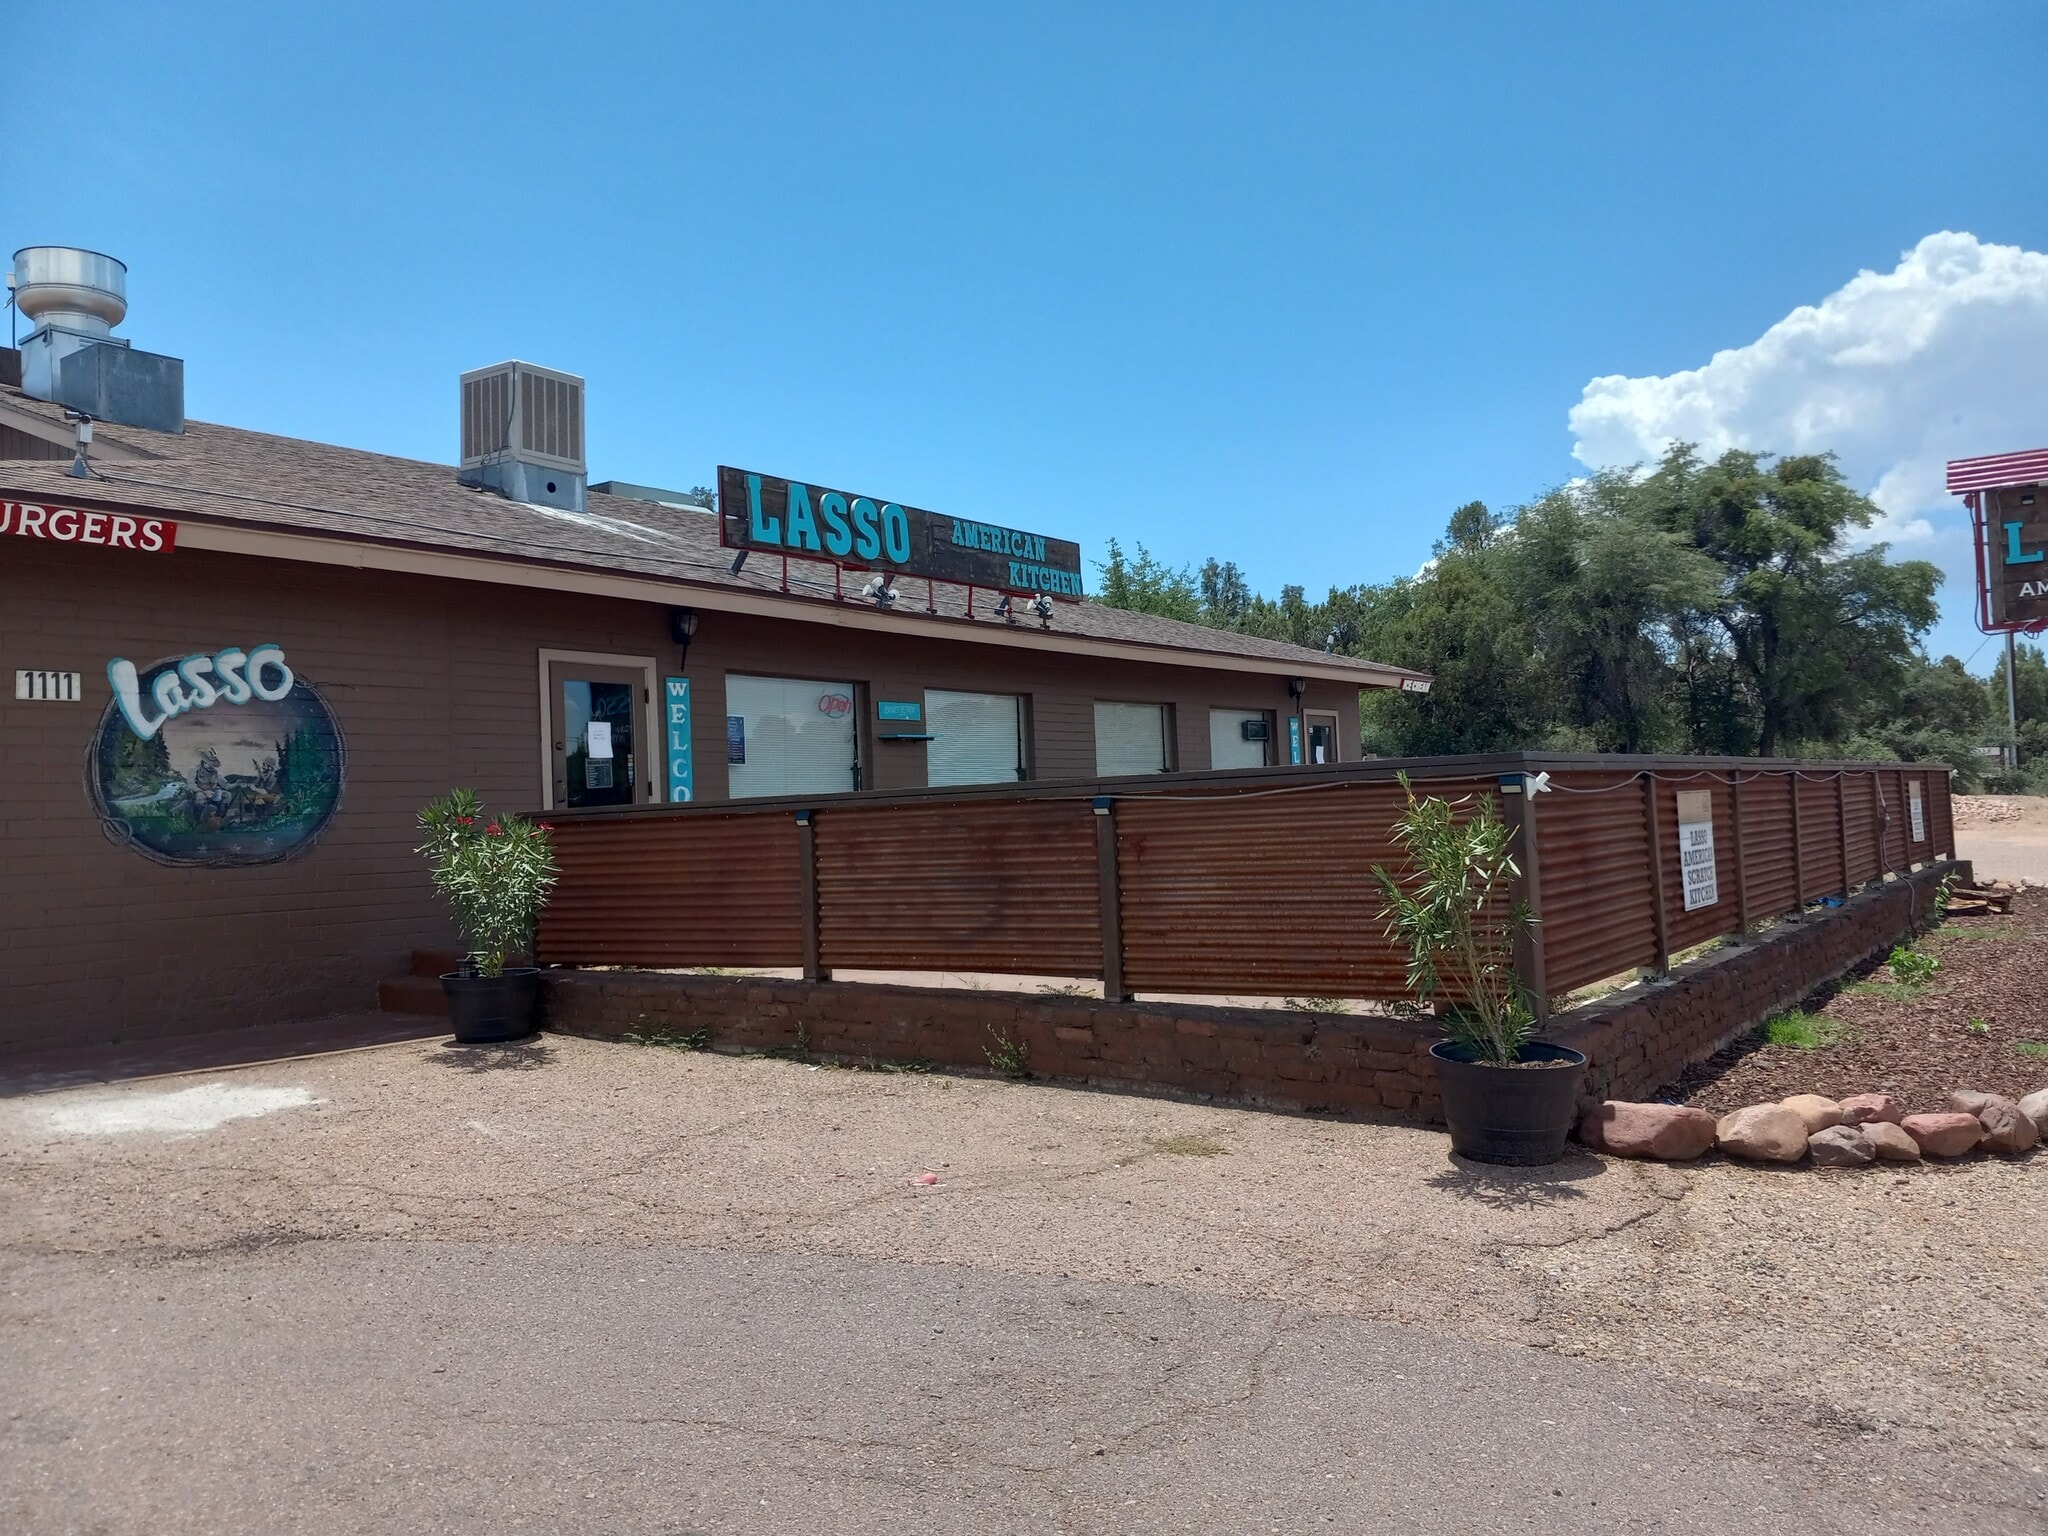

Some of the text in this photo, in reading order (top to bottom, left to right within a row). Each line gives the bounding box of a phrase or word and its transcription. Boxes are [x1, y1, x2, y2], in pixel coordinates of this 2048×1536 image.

[744, 474, 911, 564] LASSO
[952, 520, 1046, 562] AMERICAN
[1008, 561, 1081, 595] KITCHEN
[25, 672, 72, 699] 1111
